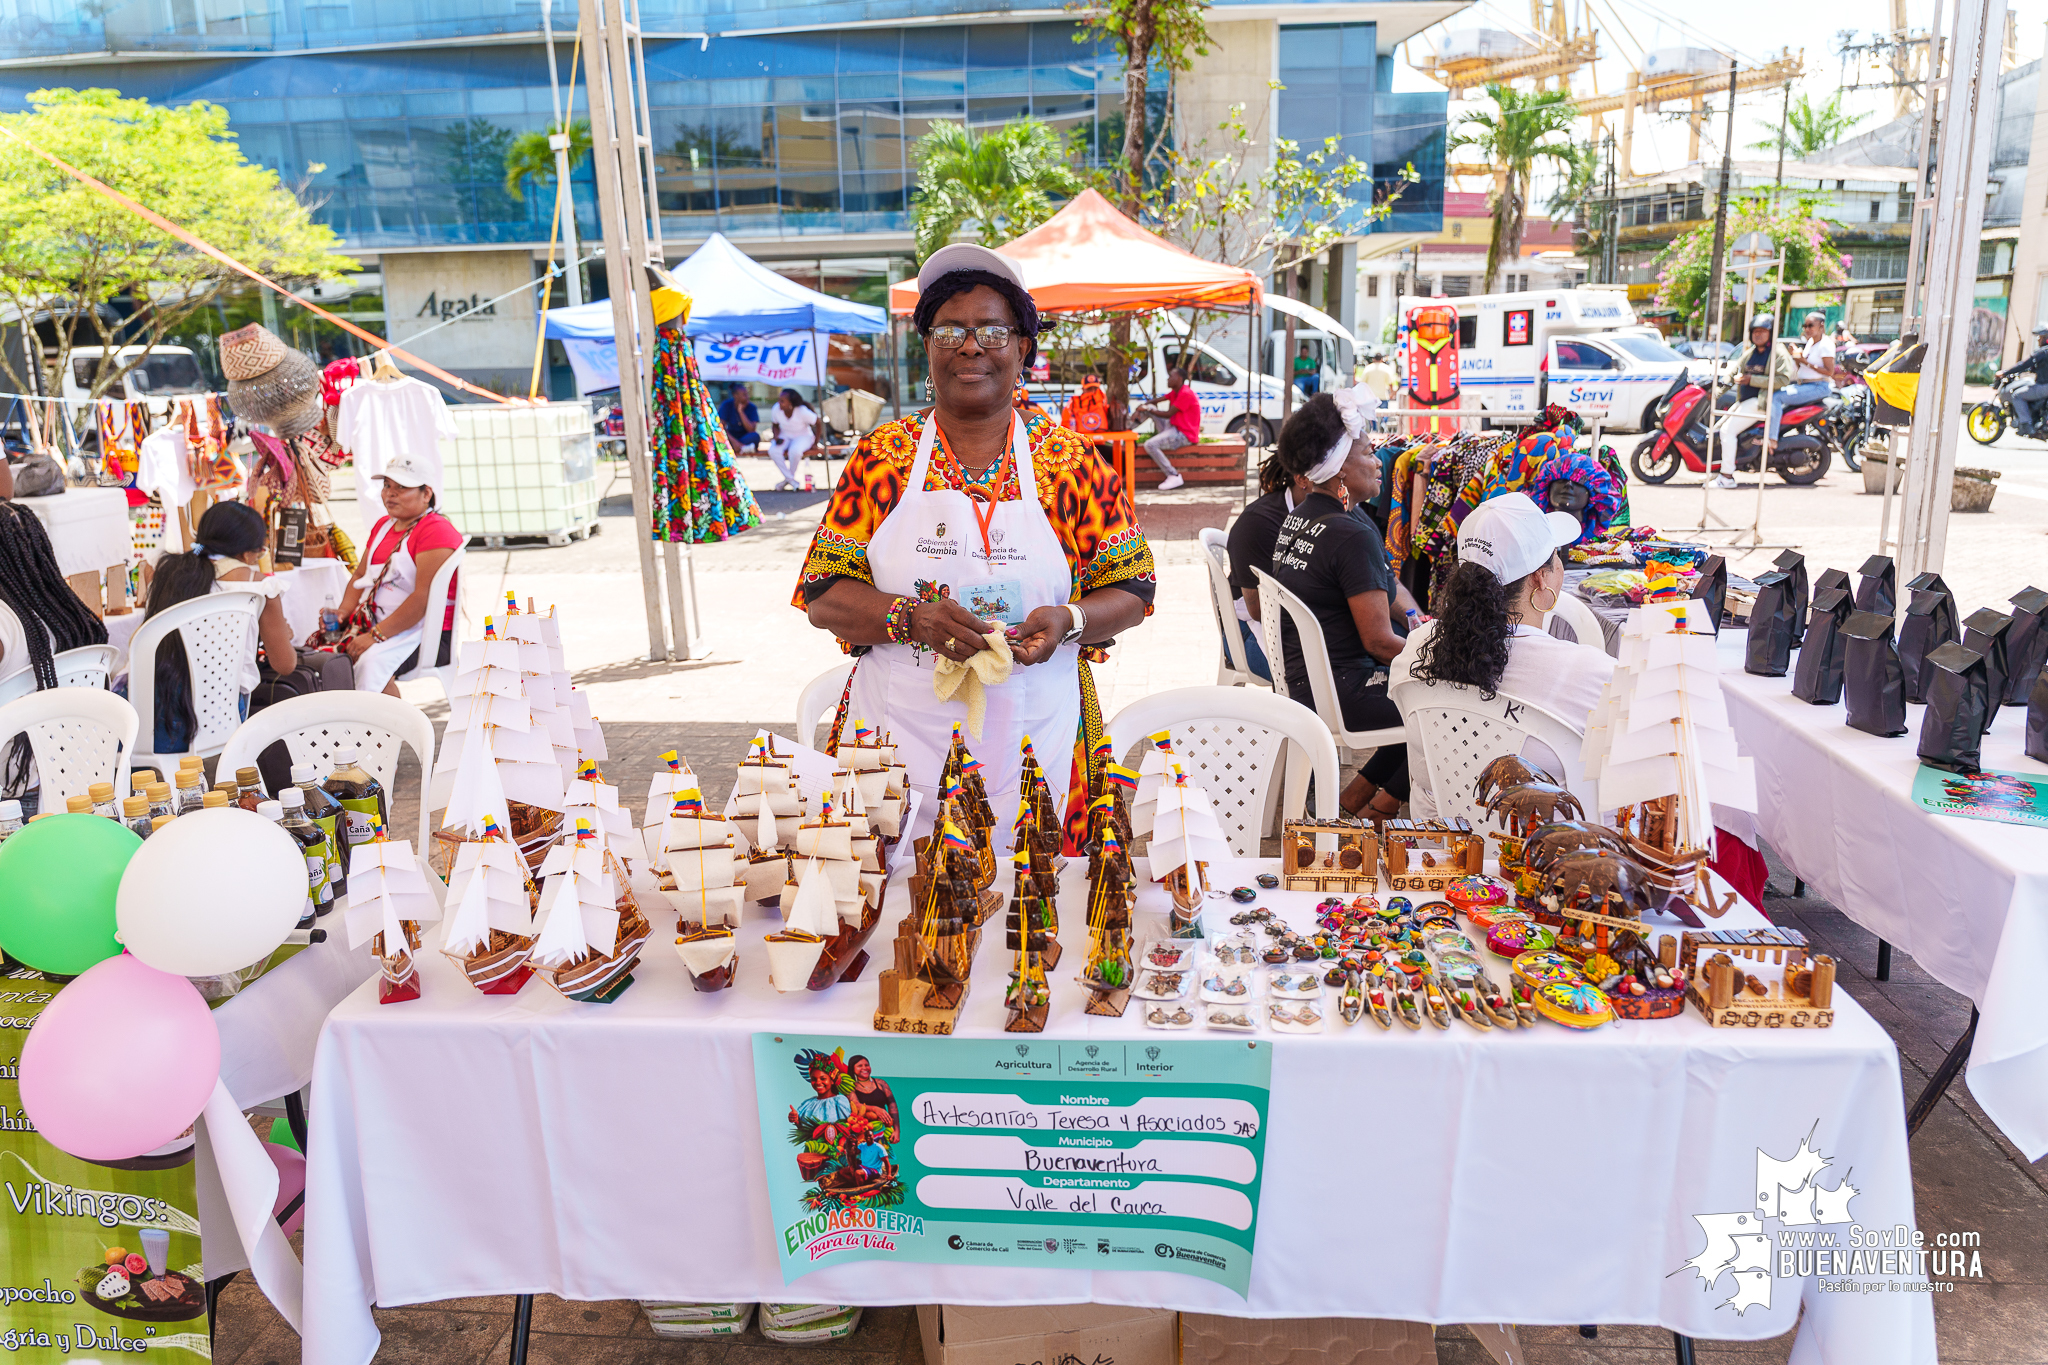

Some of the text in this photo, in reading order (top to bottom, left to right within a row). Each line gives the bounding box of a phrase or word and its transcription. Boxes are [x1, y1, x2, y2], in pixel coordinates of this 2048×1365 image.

[416, 290, 496, 326] Agata
[705, 340, 809, 365] Servi
[757, 362, 802, 379] Emer
[1461, 358, 1493, 371] ANCIA
[1569, 387, 1614, 403] Servi
[1200, 403, 1226, 413] ervi
[915, 544, 957, 556] Colombia
[918, 536, 958, 547] Gobierno de
[349, 825, 371, 834] Caña
[308, 867, 323, 878] aña
[995, 1060, 1052, 1070] Agricultura
[1136, 1063, 1174, 1072] Interior
[1060, 1095, 1110, 1106] Nombre
[1048, 1111, 1110, 1130] Teresa
[1137, 1114, 1226, 1132] Asociados
[1233, 1119, 1257, 1139] SAS
[1058, 1137, 1113, 1149] Municipio
[1025, 1149, 1163, 1173] Buenaventura
[1043, 1176, 1131, 1189] Departamento
[5, 1181, 168, 1228] Vikingos:
[1006, 1187, 1167, 1215] Valle del Cauca
[784, 1208, 925, 1257] ETNOAGROFERIA
[810, 1232, 897, 1261] para la Vida
[1175, 1246, 1196, 1255] Cámara
[1203, 1250, 1227, 1263] Comercio
[1175, 1250, 1226, 1269] Buenaventura
[0, 1278, 76, 1306] pocho
[55, 1331, 71, 1353] y
